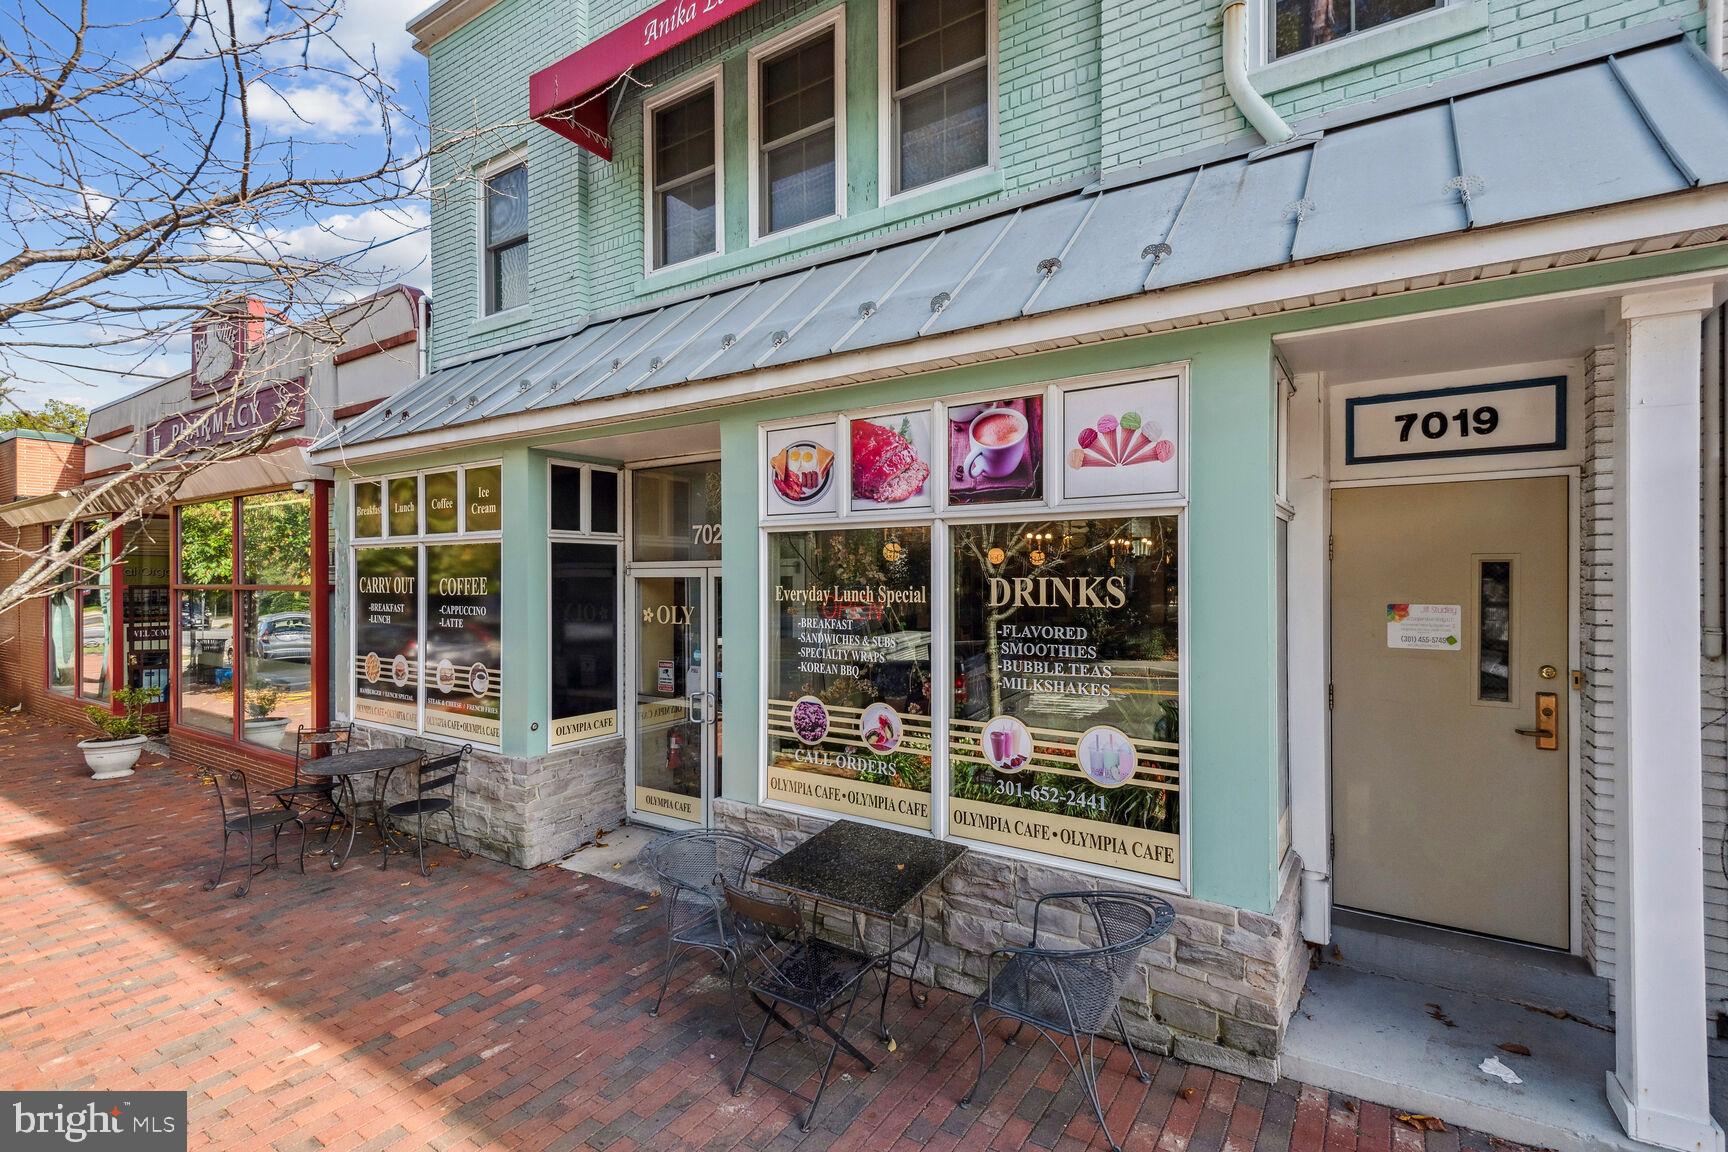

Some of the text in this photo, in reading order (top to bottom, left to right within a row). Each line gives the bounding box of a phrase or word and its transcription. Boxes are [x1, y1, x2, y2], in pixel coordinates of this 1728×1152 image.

[644, 0, 697, 46] Anika
[1394, 405, 1499, 442] 7019
[478, 486, 490, 498] Ice
[356, 506, 382, 516] Breakfas
[394, 502, 415, 513] Lunch
[431, 498, 454, 510] Coffee
[471, 503, 497, 514] Cream
[359, 576, 415, 594] CARRY OUT
[439, 576, 488, 596] COFFEE
[987, 575, 1126, 609] DRINKS
[775, 585, 927, 607] Everyday Lunch Special
[368, 603, 405, 612] -BREAKFAST
[439, 605, 487, 616] -CAPPUCCINO
[656, 605, 695, 625] OLY
[368, 614, 391, 624] -LUNCH
[439, 617, 464, 628] -LATTE
[798, 617, 853, 630] -BREAKFAST
[133, 629, 169, 637] WELCOM
[798, 632, 896, 648] -SANDWICHES & SUBS
[997, 624, 1088, 640] -FLAVORED
[798, 647, 885, 663] -SPECIALTY WRAPS
[798, 661, 860, 678] -KOREAN BBQ
[997, 659, 1112, 679] -BUBBLE TEAS
[997, 677, 1111, 697] -MILKSHAKES
[427, 697, 441, 705] STEAK
[445, 700, 462, 709] CHEESE
[466, 703, 484, 712] FRENCH
[485, 706, 498, 714] FRIES
[426, 715, 500, 738] OLYMPIA CAFE OLYMPIA CAFE
[555, 717, 613, 737] OLYMPIA CAFE
[795, 748, 897, 777] CALL ORDERS
[770, 776, 928, 818] OLYMPIA CAFE OLYMPIA CAFE
[996, 779, 1107, 811] 301-652-2441
[645, 795, 692, 814] OLYMPIA CAFE
[953, 809, 1175, 864] OLYMPIA CAFE OLYMPIA CAFE
